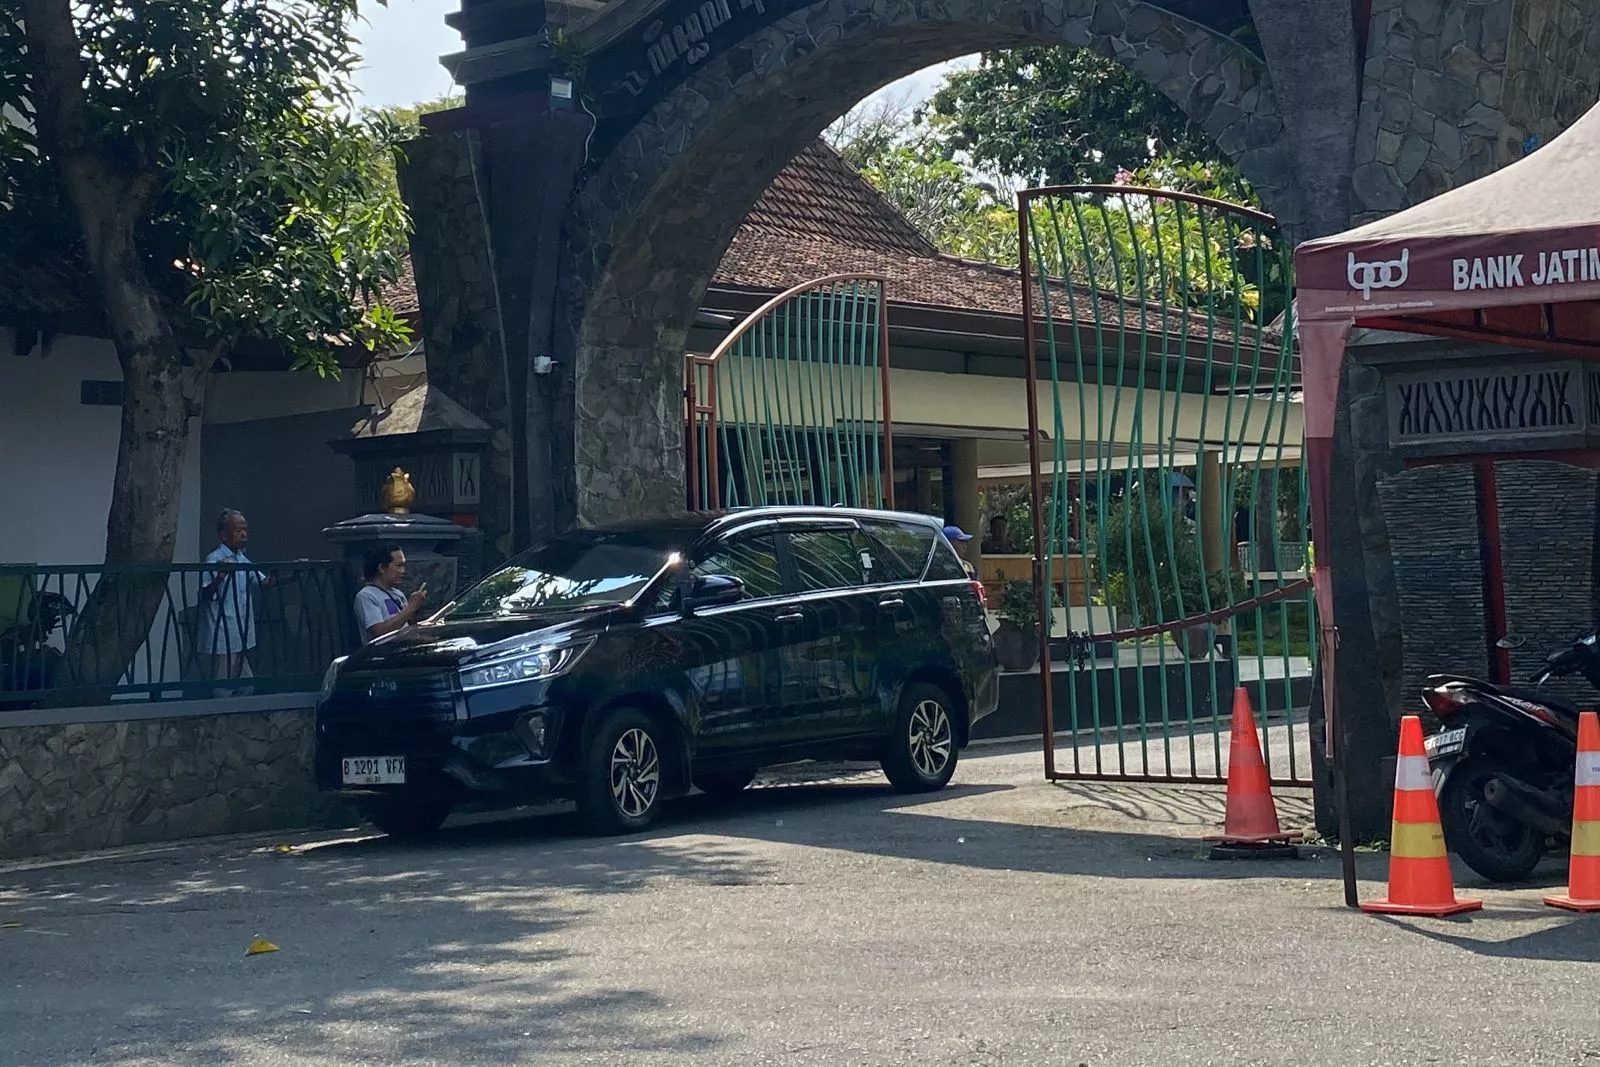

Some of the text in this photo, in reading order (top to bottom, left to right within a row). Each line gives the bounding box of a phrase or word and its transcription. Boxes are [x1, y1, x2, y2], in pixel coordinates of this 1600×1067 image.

[1452, 254, 1525, 291] BANK
[343, 758, 405, 775] B 1201 VFX
